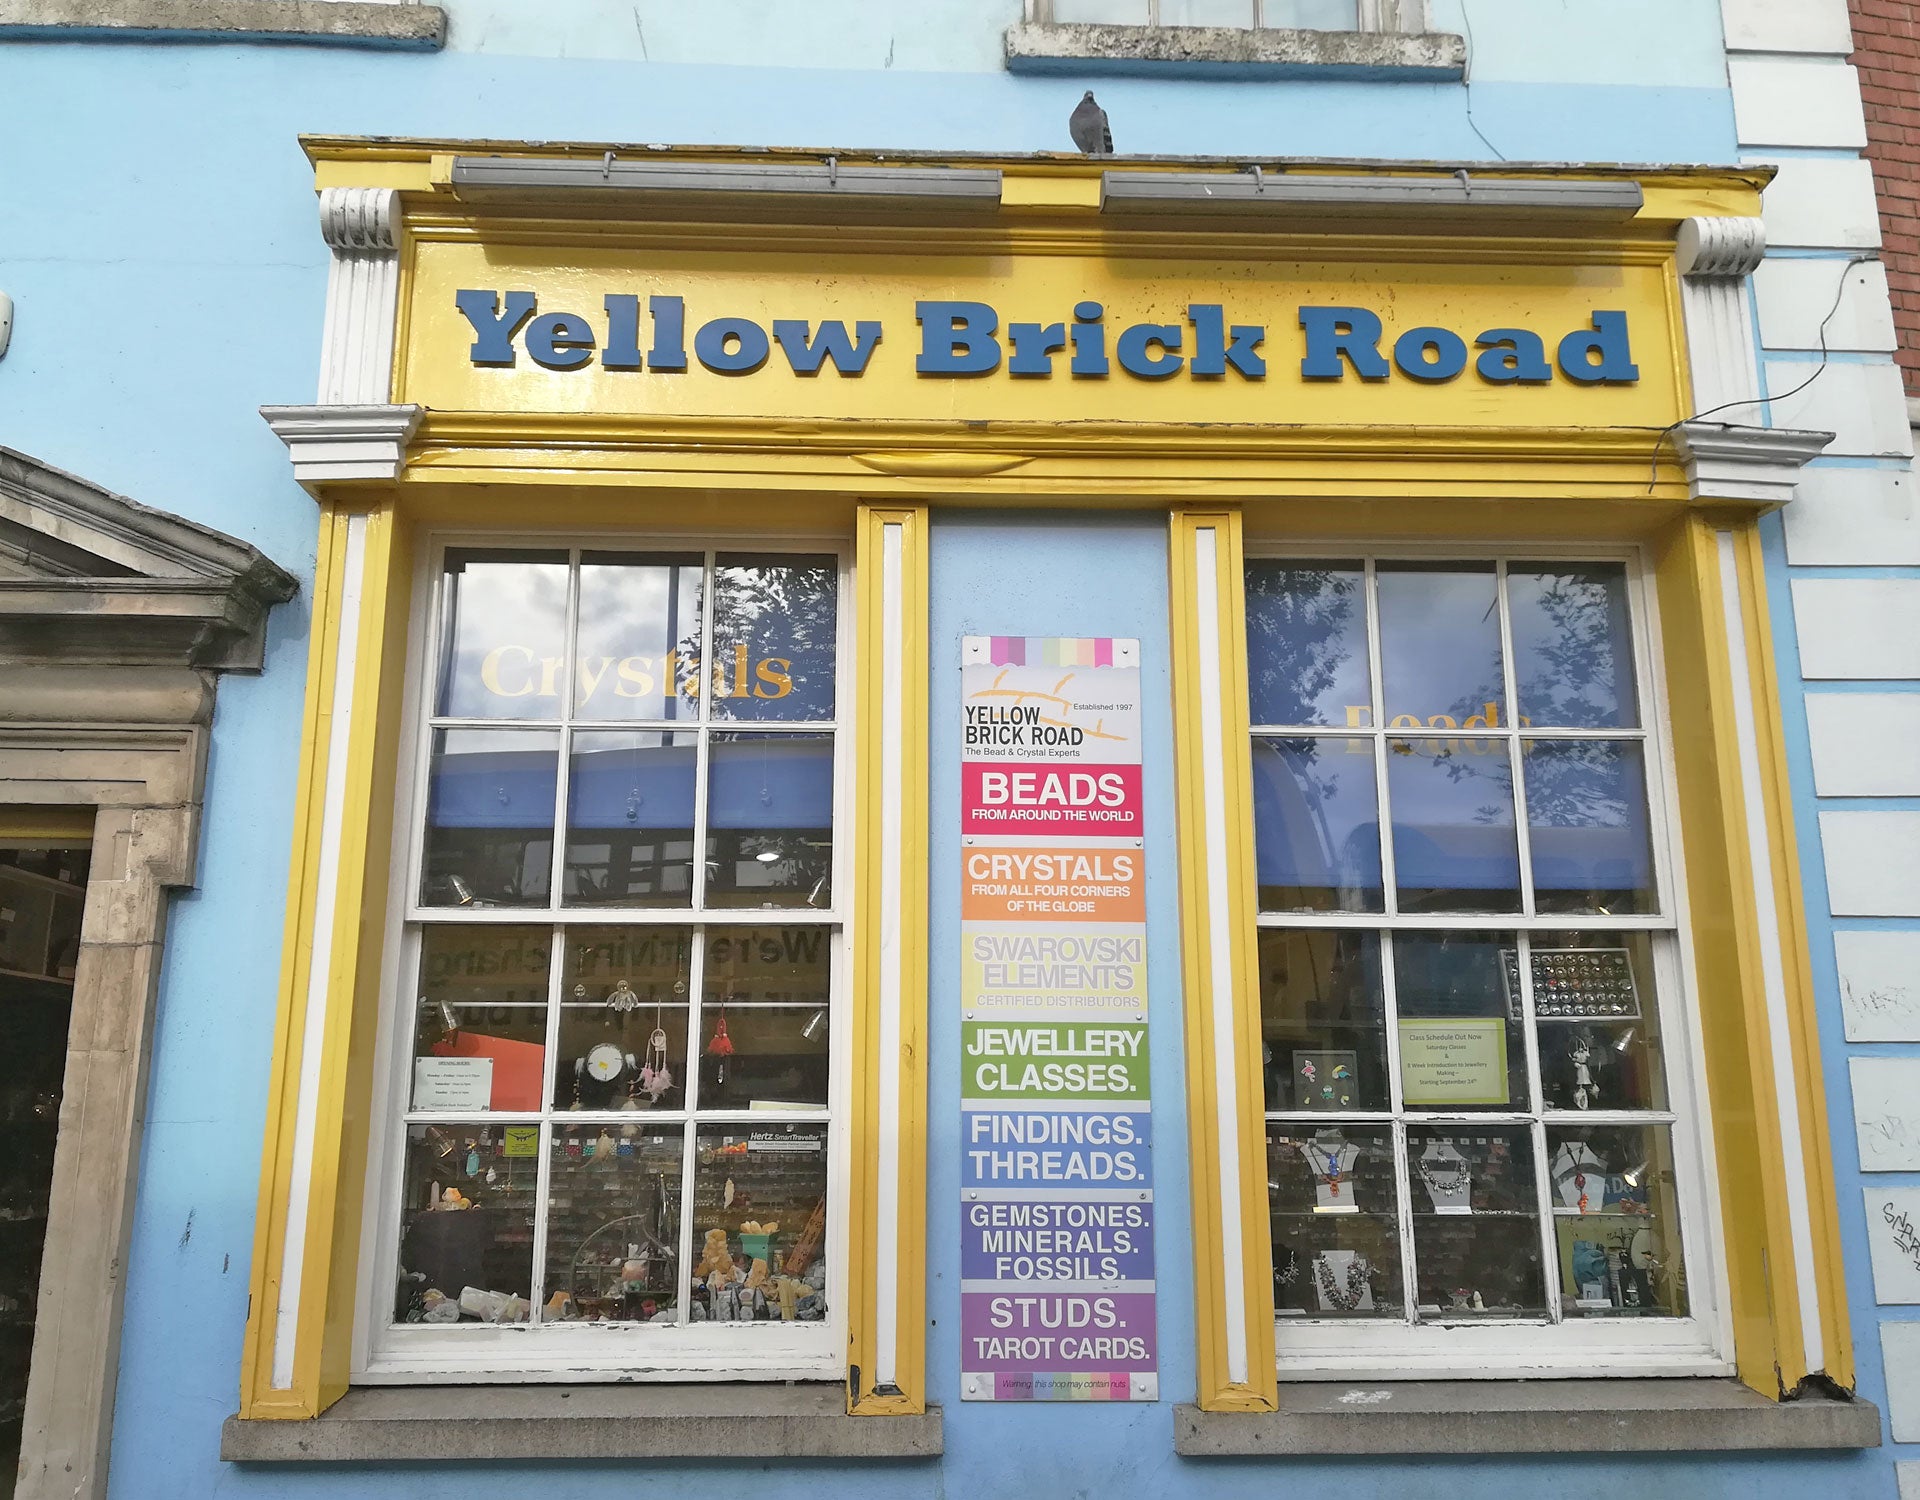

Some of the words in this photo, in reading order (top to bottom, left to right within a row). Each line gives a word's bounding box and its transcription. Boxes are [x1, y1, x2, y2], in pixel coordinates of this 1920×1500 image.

[456, 289, 882, 374] Yellow
[915, 301, 1266, 378] Brick
[1298, 305, 1640, 385] Road
[481, 644, 793, 707] Crystals
[965, 705, 1041, 726] YELLOW
[1073, 703, 1114, 711] Established
[1116, 703, 1133, 711] 1997
[965, 726, 1024, 745] BRICK
[1032, 727, 1084, 746] ROAD
[965, 747, 981, 756] The
[984, 748, 1006, 756] Bead
[1008, 748, 1014, 756] &
[1017, 749, 1046, 758] Crystal
[1049, 749, 1080, 758] Experts
[982, 772, 1126, 807] BEADS
[972, 809, 1007, 820] FROM
[1009, 809, 1061, 821] AROUND
[1063, 810, 1089, 821] THE
[1090, 810, 1134, 822] WORLD
[968, 854, 1134, 881] CRYSTALS
[971, 885, 1007, 896] FROM
[1009, 885, 1032, 896] ALL
[1035, 885, 1068, 897] FOUR
[1070, 886, 1131, 897] CORNERS
[1007, 901, 1026, 912] OF
[1028, 901, 1051, 912] THE
[1052, 902, 1095, 913] GLOBE
[974, 936, 1141, 963] SWAROVSKI
[984, 964, 1134, 990] ELEMENTS
[977, 995, 1042, 1006] CERTIFIED
[1047, 995, 1140, 1008] DISTRIBUTORS
[967, 1029, 1144, 1056] JEWELLERY
[976, 1063, 1136, 1092] CLASSES.
[750, 1132, 773, 1140] Hertz
[971, 1115, 1142, 1145] FINDINGS.
[969, 1151, 1144, 1181] THREADS.
[970, 1205, 1149, 1227] GEMSTONES.
[982, 1231, 1138, 1254] MINERALS.
[996, 1257, 1126, 1280] FOSSILS.
[990, 1298, 1126, 1328] STUDS.
[973, 1337, 1055, 1359] TAROT
[1059, 1337, 1150, 1360] CARDS.
[1035, 1380, 1046, 1388] this
[1048, 1380, 1066, 1389] shop
[1067, 1380, 1084, 1390] may
[1084, 1380, 1109, 1388] contain
[1110, 1380, 1126, 1388] nuts
